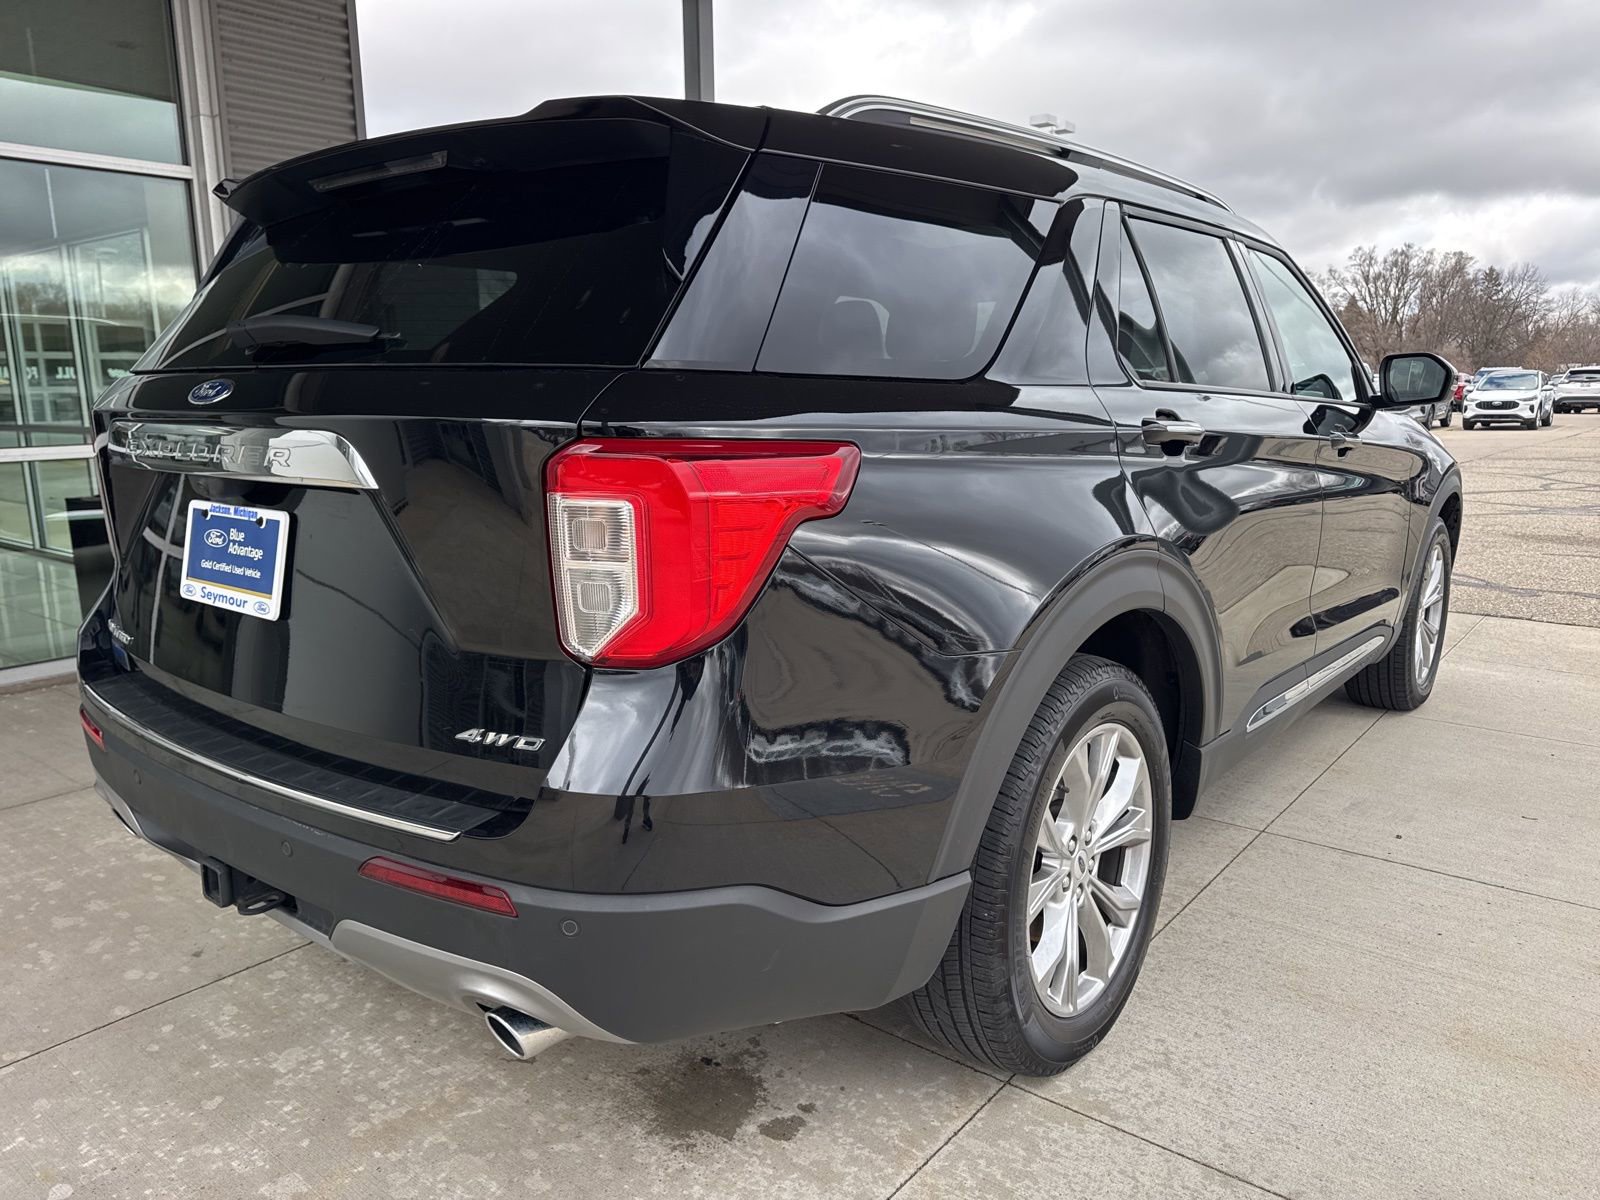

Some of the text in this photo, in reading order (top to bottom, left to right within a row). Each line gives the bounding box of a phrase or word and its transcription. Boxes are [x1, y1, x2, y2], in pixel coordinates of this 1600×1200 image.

[191, 381, 227, 401] Ford
[127, 438, 291, 467] EXPLORER
[234, 507, 258, 520] Michigan
[229, 528, 245, 542] Blue
[228, 542, 264, 560] Advantage
[200, 560, 261, 578] Gold Certified Used Vehicle
[200, 586, 248, 608] Seymour
[454, 728, 546, 752] 4WD
